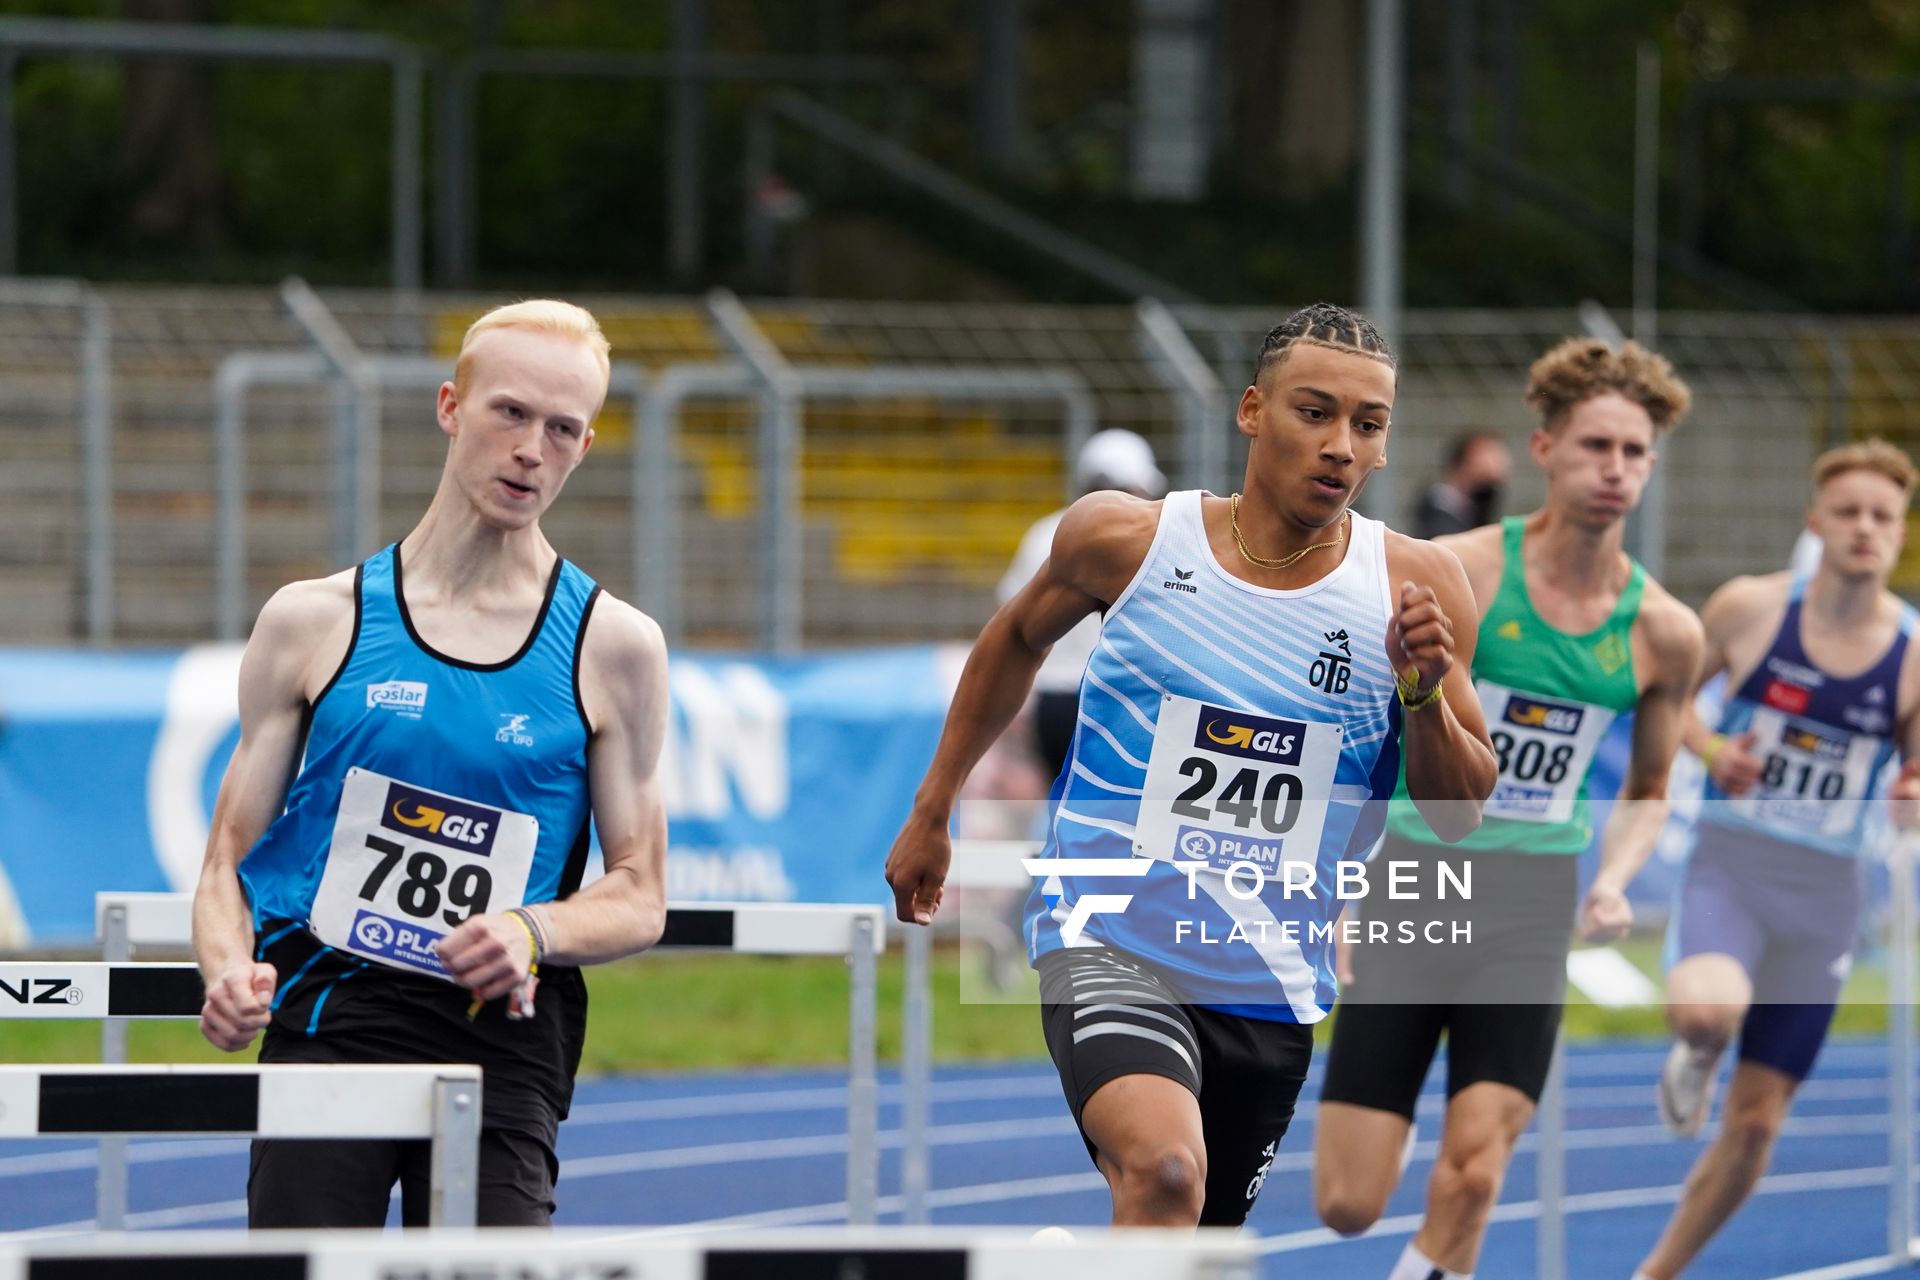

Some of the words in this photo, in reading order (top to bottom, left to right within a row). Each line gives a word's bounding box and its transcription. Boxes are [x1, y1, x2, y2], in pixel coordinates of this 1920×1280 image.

[1163, 580, 1198, 594] erima
[1309, 651, 1352, 694] OTB
[1252, 731, 1296, 755] GLS
[1490, 731, 1575, 784] 808
[1171, 756, 1304, 835] 240
[1760, 752, 1845, 802] 810
[440, 815, 490, 845] GLS
[1219, 839, 1278, 863] PLAN
[358, 833, 493, 929] 789
